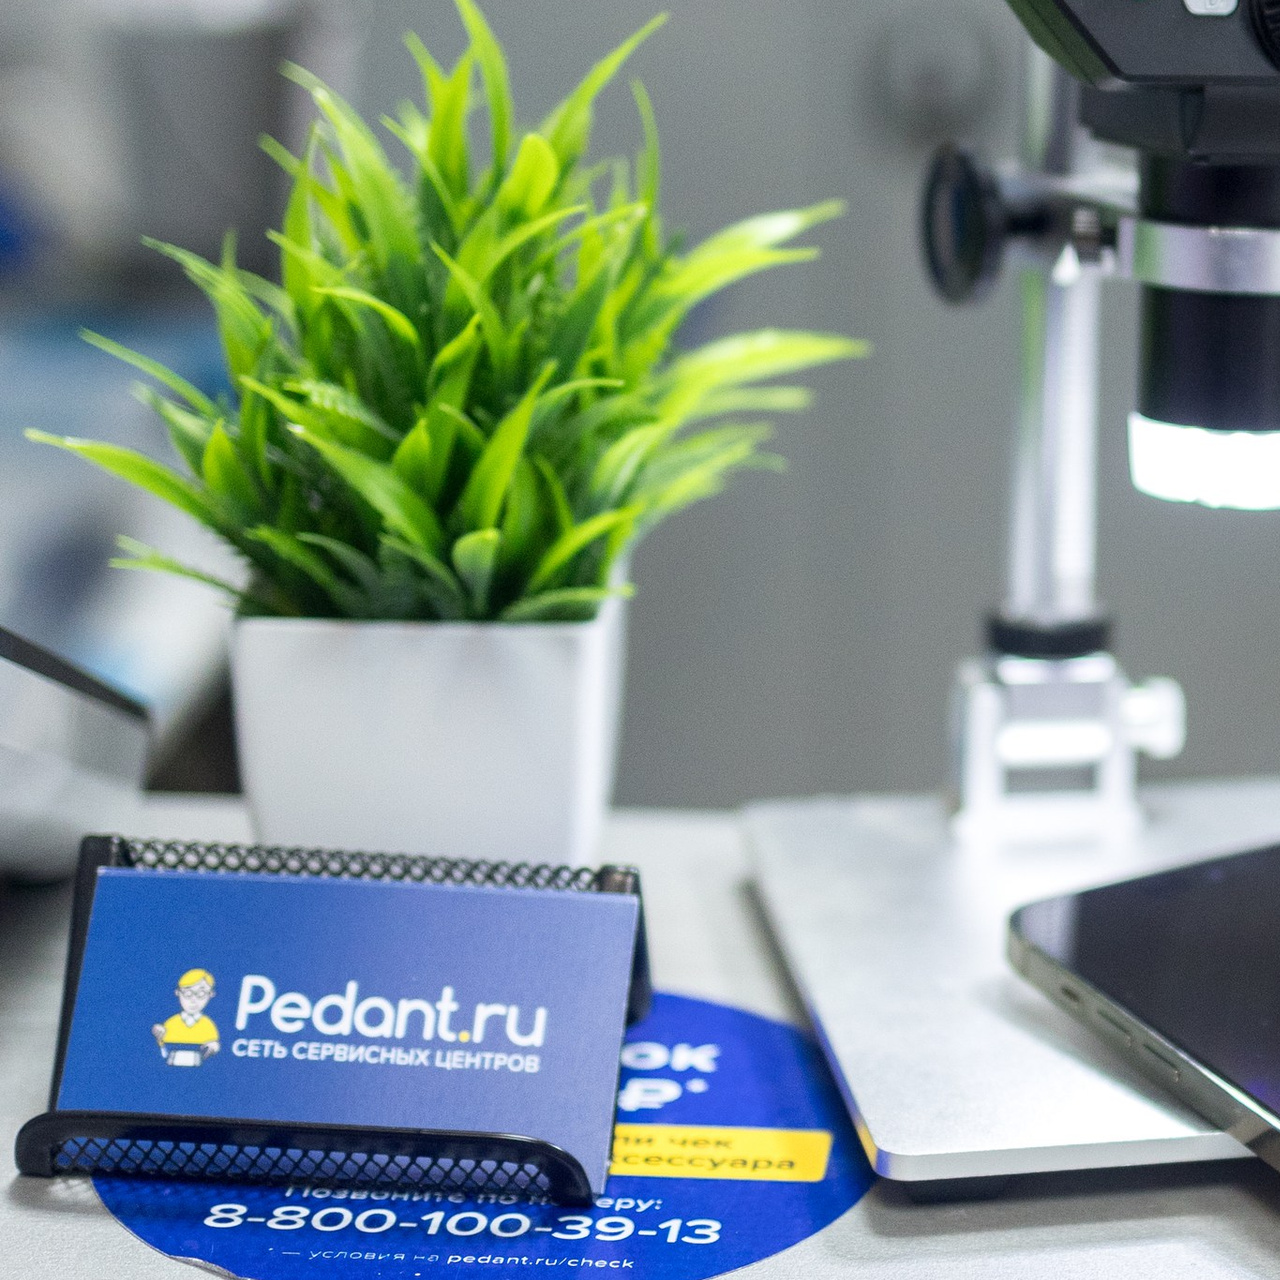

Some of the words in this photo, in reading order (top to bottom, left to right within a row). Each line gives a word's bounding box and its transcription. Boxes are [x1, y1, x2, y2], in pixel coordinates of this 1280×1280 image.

[235, 974, 548, 1048] Pedant.ru
[231, 1037, 288, 1059] СЕТЬ
[291, 1041, 430, 1067] СЕРВИСНЫХ
[434, 1051, 541, 1073] ЦЕНТРОВ
[203, 1203, 723, 1245] 8-800-100-39-13
[308, 1250, 406, 1261] условия
[446, 1253, 635, 1270] pedant.ru/check
